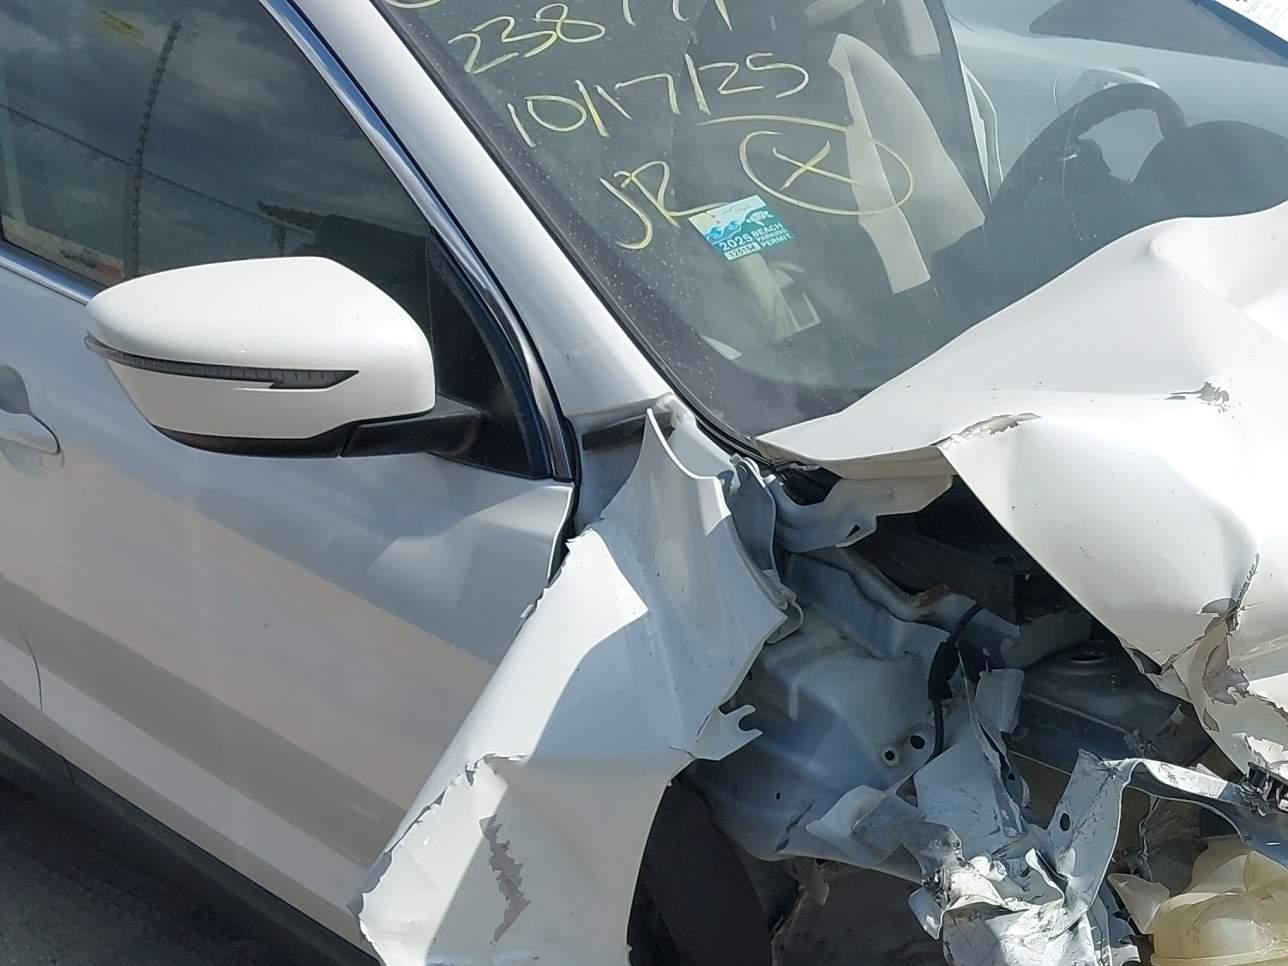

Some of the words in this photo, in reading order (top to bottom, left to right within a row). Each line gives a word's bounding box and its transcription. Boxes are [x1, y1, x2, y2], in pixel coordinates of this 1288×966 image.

[507, 52, 809, 148] 10/17/25
[719, 233, 753, 251] 2025
[751, 222, 784, 238] BEACH
[755, 228, 788, 243] PARKING
[760, 233, 792, 248] PERMIT
